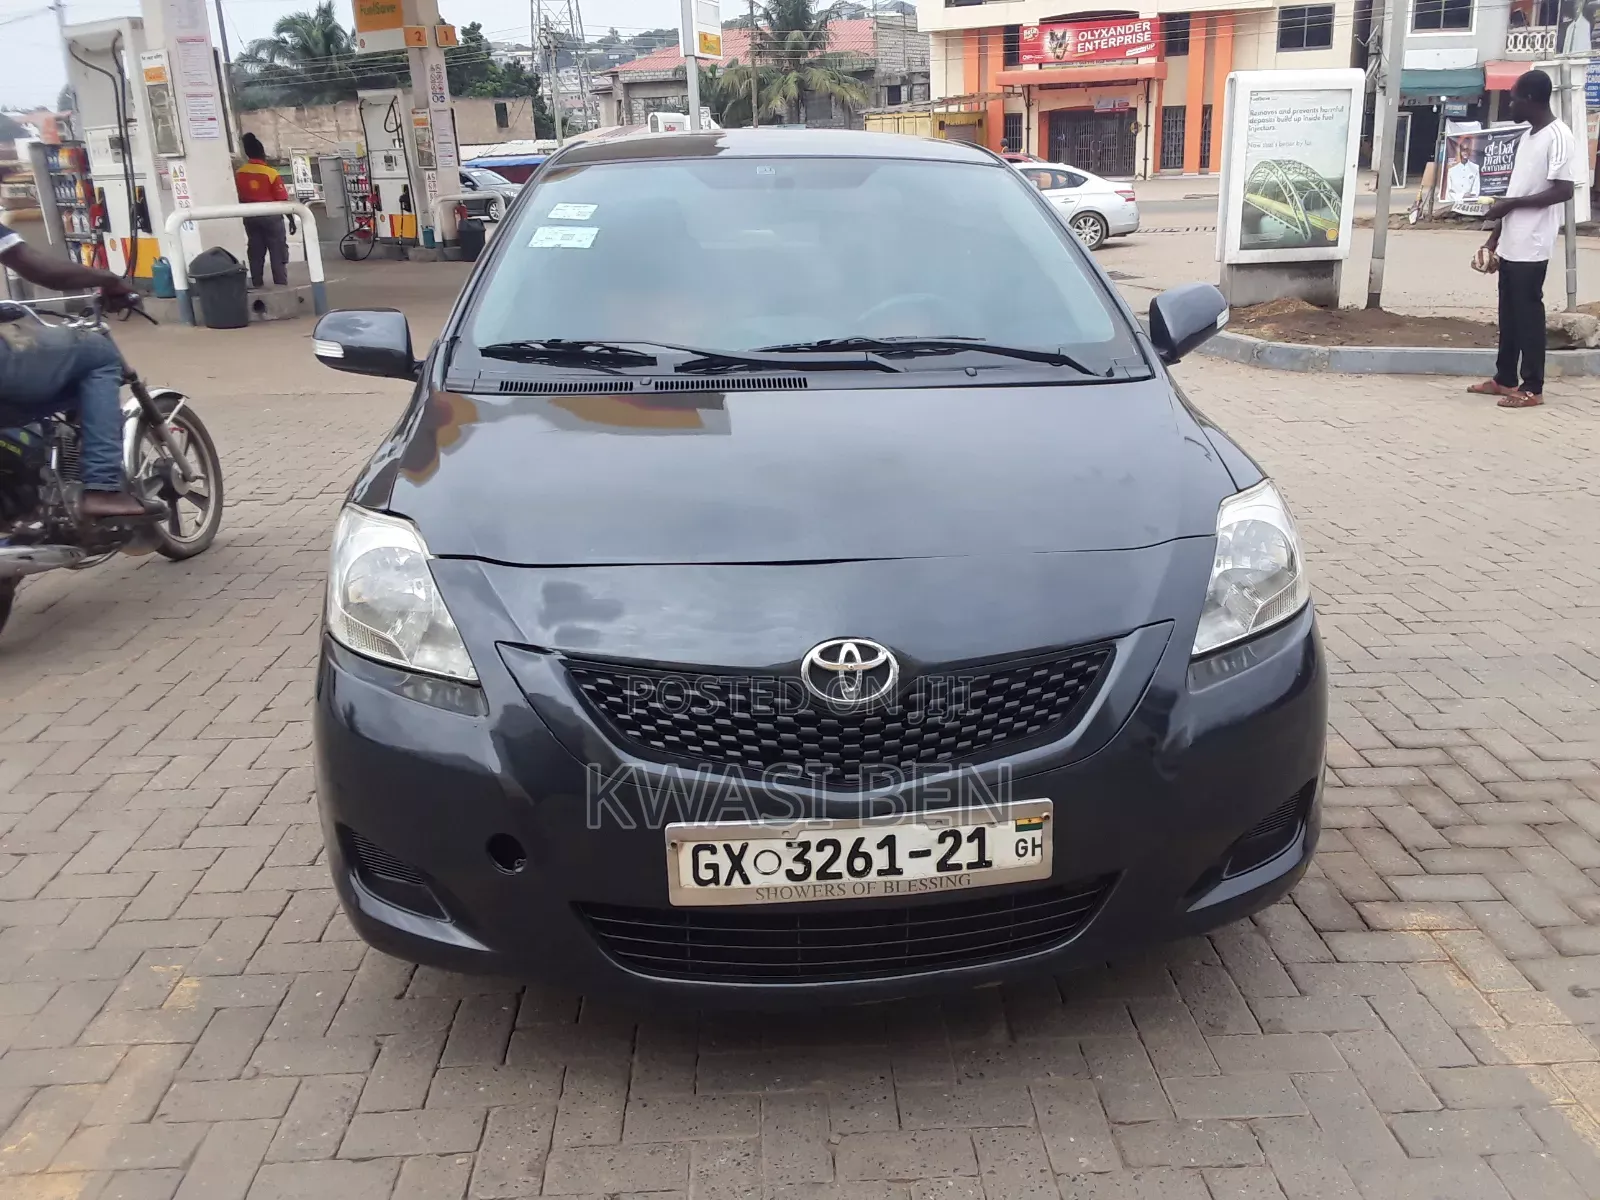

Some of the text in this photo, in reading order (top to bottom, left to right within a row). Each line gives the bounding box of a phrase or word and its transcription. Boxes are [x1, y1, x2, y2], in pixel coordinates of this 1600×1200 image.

[414, 31, 423, 42] 2
[443, 31, 449, 42] 1
[1077, 31, 1152, 53] ENTERPRISE
[1078, 21, 1151, 42] OLYXANDER
[1292, 108, 1319, 116] prevents
[1484, 139, 1516, 156] global
[691, 826, 993, 887] GX 3261-21
[1015, 836, 1043, 858] GH
[755, 873, 972, 902] SHOWERS OF BLESSING
